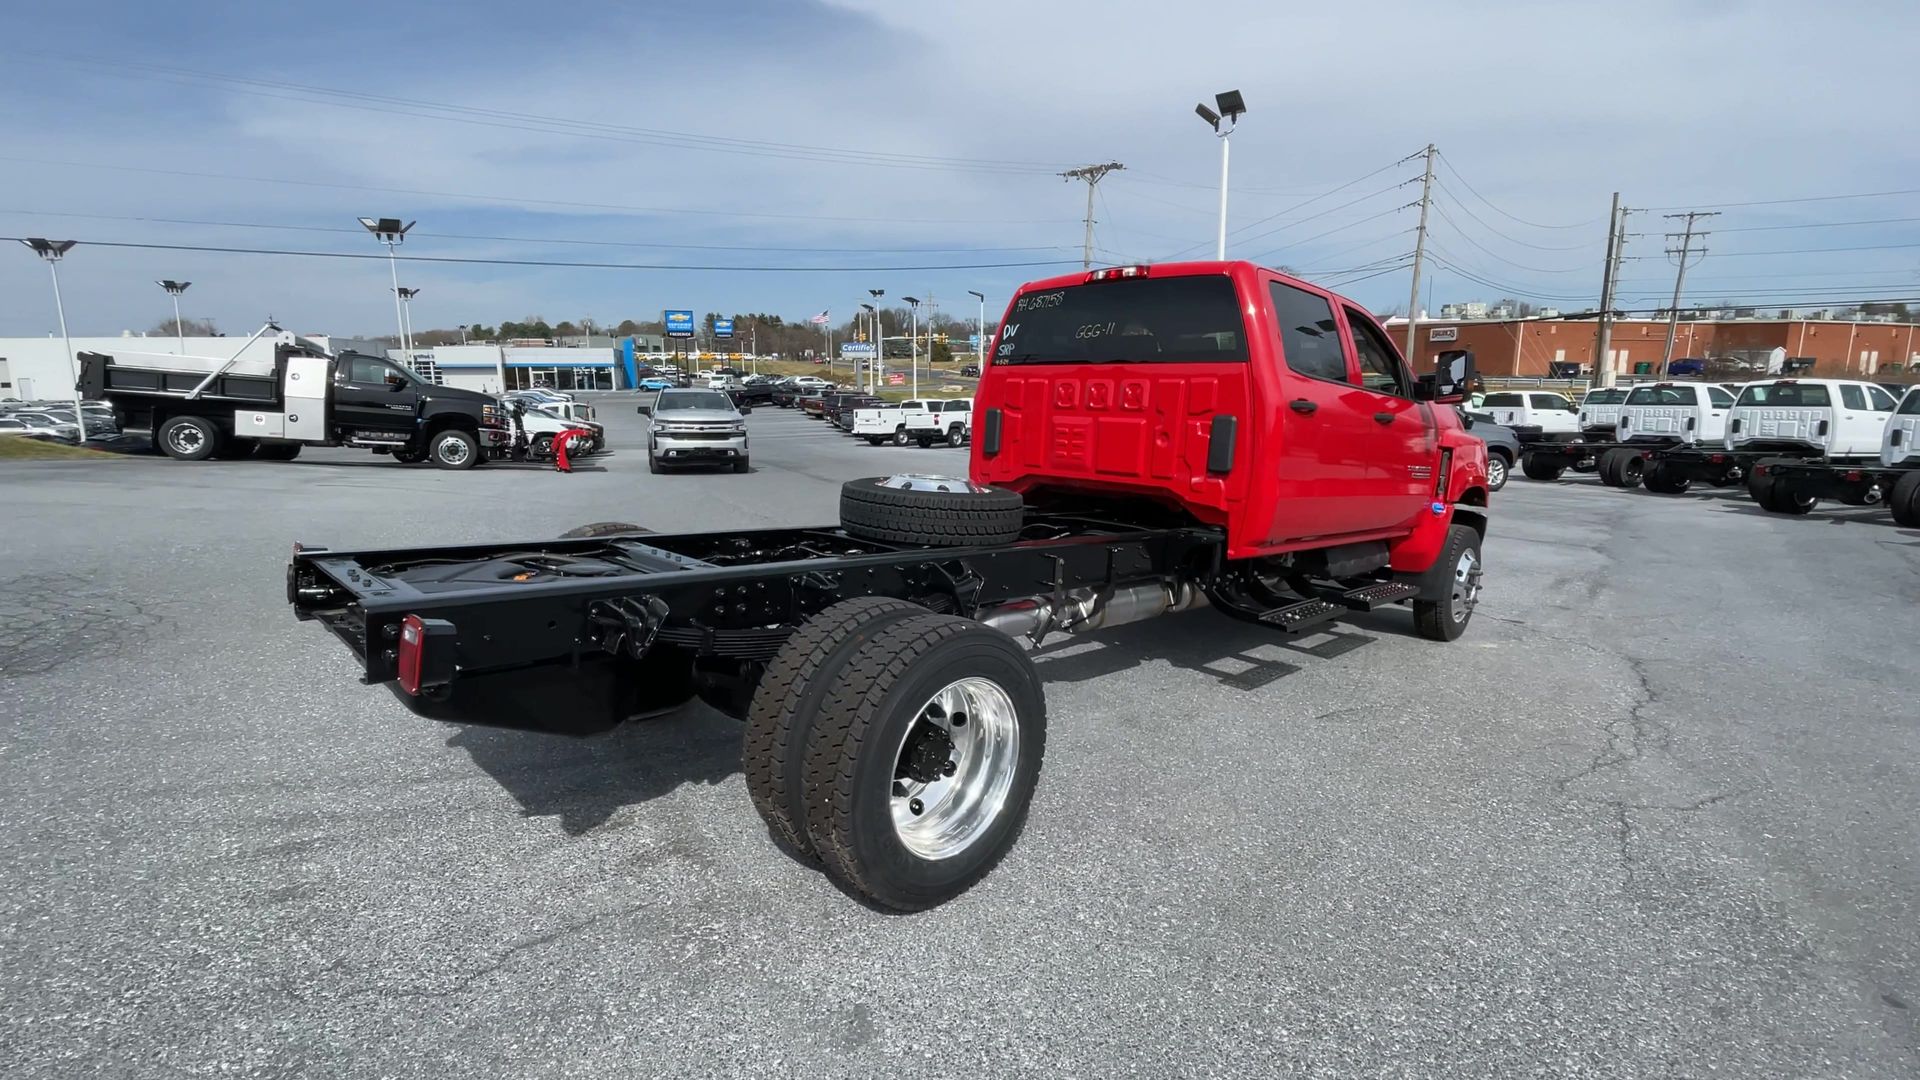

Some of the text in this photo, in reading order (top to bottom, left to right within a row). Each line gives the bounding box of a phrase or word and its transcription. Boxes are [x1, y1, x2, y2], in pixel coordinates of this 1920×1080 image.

[1002, 323, 1020, 341] DV
[1074, 321, 1116, 339] GGG-11
[842, 343, 876, 351] Certified
[998, 343, 1016, 357] SRP
